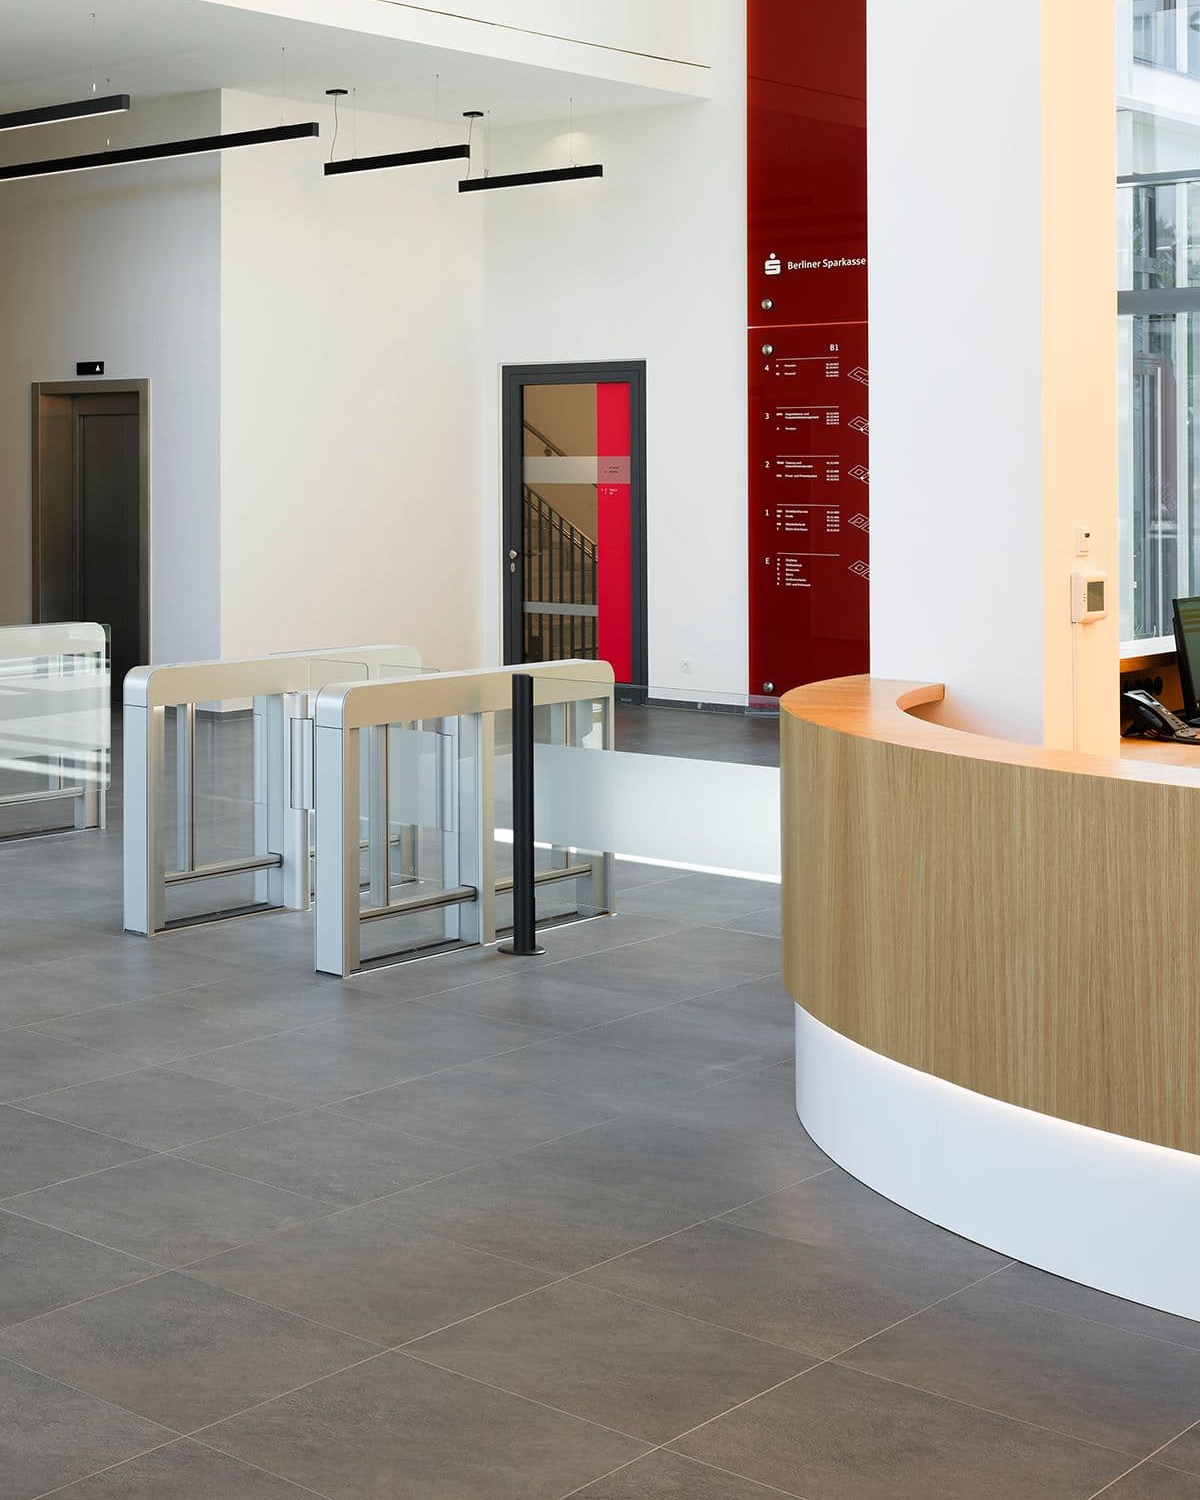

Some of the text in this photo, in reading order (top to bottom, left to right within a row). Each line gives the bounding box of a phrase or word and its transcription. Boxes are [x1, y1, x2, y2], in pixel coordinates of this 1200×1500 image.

[787, 260, 821, 270] Berliner
[822, 258, 866, 268] Sparkasse
[829, 343, 839, 352] B1
[764, 364, 770, 372] 4
[764, 412, 770, 420] 3
[765, 460, 770, 469] 2
[765, 509, 769, 517] 1
[765, 557, 770, 565] E
